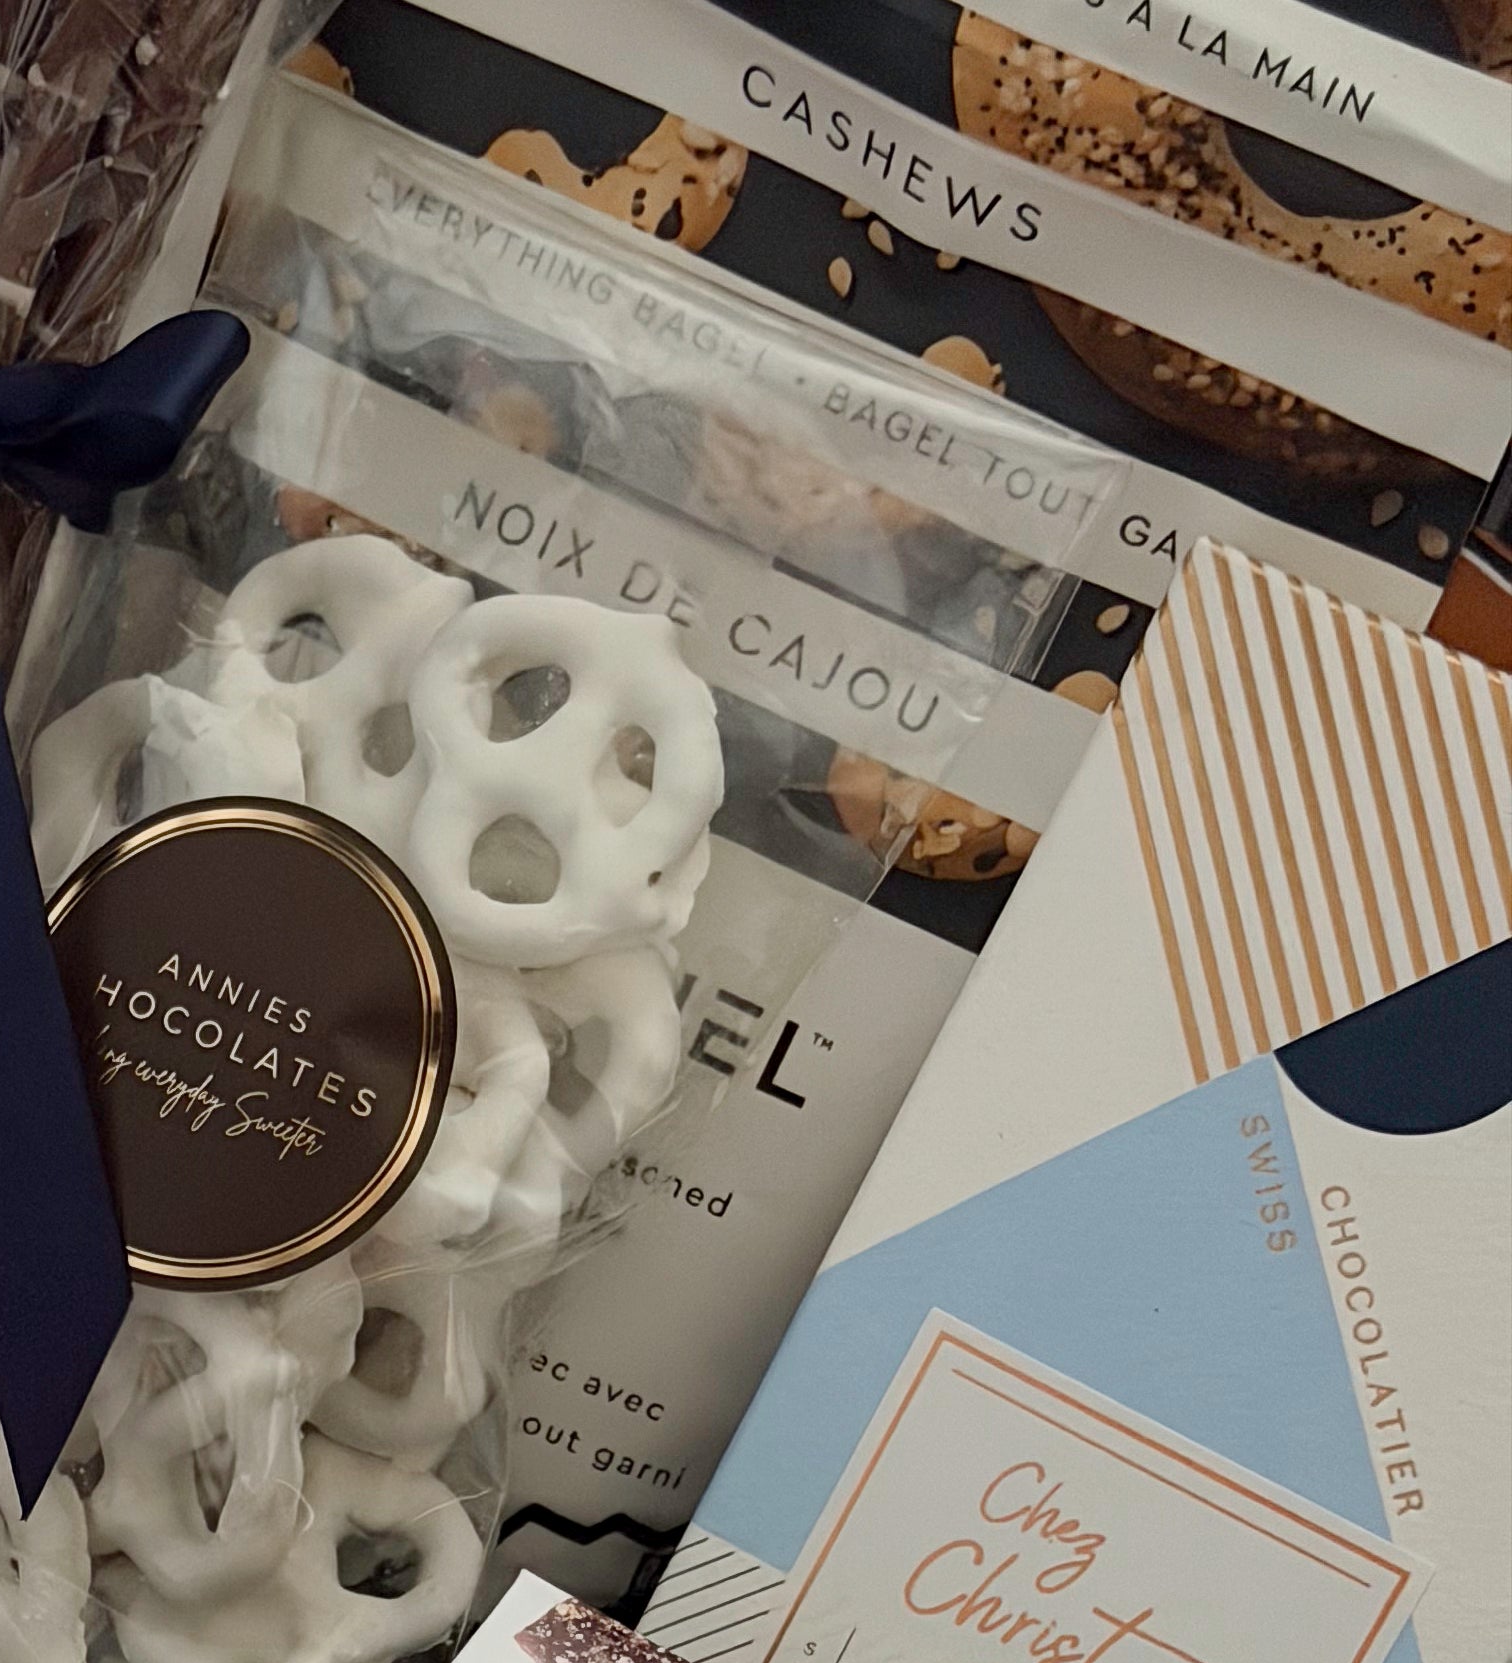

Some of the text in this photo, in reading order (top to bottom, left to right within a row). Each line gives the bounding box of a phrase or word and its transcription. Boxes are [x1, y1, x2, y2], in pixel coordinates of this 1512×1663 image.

[1177, 15, 1228, 66] LA
[1251, 47, 1376, 123] MAIN
[741, 65, 1044, 243] CASHEWS
[365, 163, 617, 306] EVERYTHING
[632, 292, 772, 381] BAGEL
[823, 384, 956, 468] BAGEL
[983, 450, 1094, 524] TOUT
[453, 480, 940, 733] NOIX DE CAJOU
[158, 953, 312, 1033] ANNIES
[135, 1072, 226, 1132] everyday
[225, 1091, 326, 1161] Sweeter
[1240, 1114, 1298, 1254] SWISS
[583, 1376, 665, 1421] avec
[1320, 1185, 1425, 1517] CHOCOLATIER
[592, 1447, 687, 1490] garni
[979, 1461, 1107, 1594] Chez
